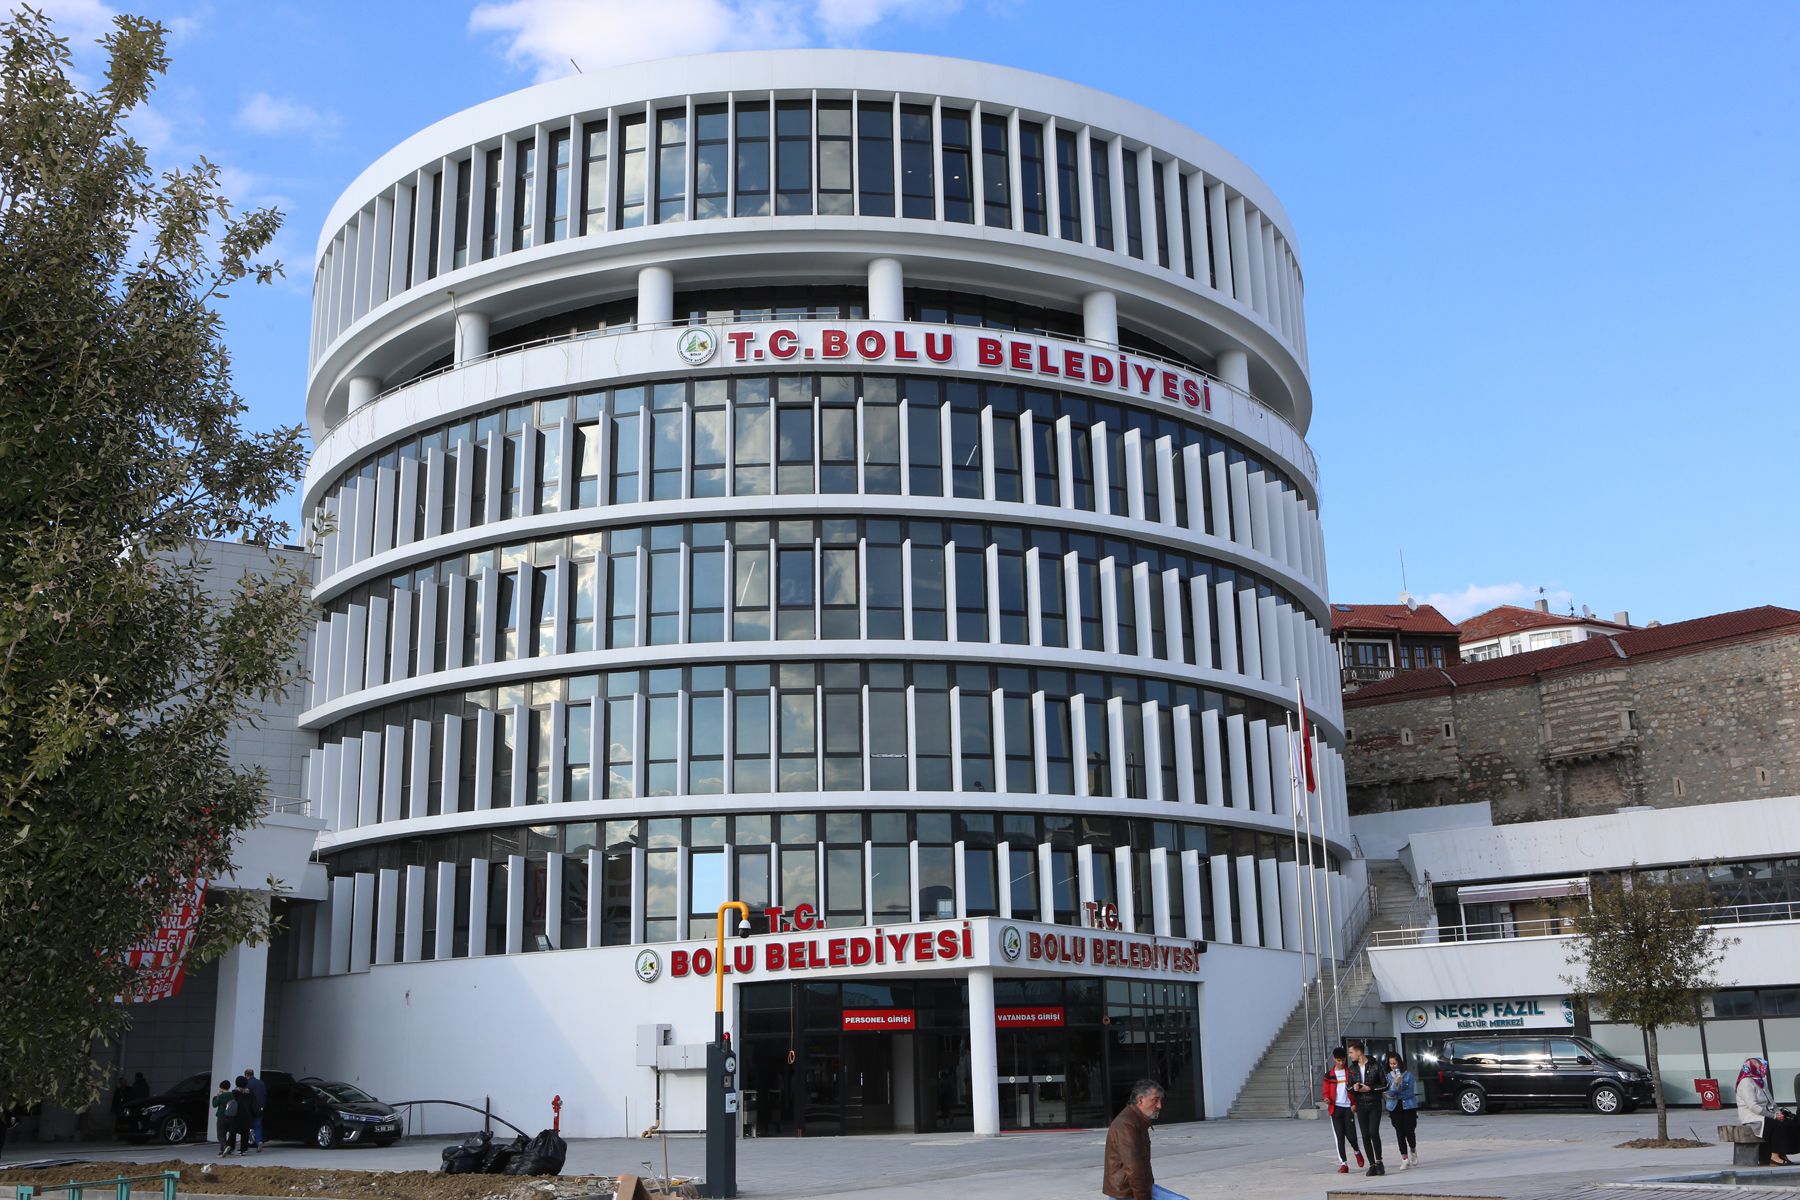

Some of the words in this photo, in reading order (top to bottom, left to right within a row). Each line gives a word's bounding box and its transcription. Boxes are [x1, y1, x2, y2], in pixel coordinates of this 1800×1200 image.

[978, 337, 1212, 413] BELEDİYESİ
[764, 902, 826, 933] T.C.
[1085, 902, 1123, 931] T.C.
[766, 921, 974, 971] BELEDİYESİ
[1028, 931, 1085, 964] BOLU
[1092, 937, 1200, 972] BELEDİYESİ
[845, 1016, 885, 1024] PERSONEL
[887, 1014, 911, 1024] GİRİŞİ
[998, 1014, 1036, 1022] VATANDAŞ
[1037, 1012, 1060, 1022] GİRİŞİ
[1434, 1003, 1488, 1019] NECİP
[1493, 1001, 1545, 1017] FAZIL
[1457, 1019, 1487, 1029] KÜLTÜR
[1489, 1017, 1524, 1028] MERKEZİ
